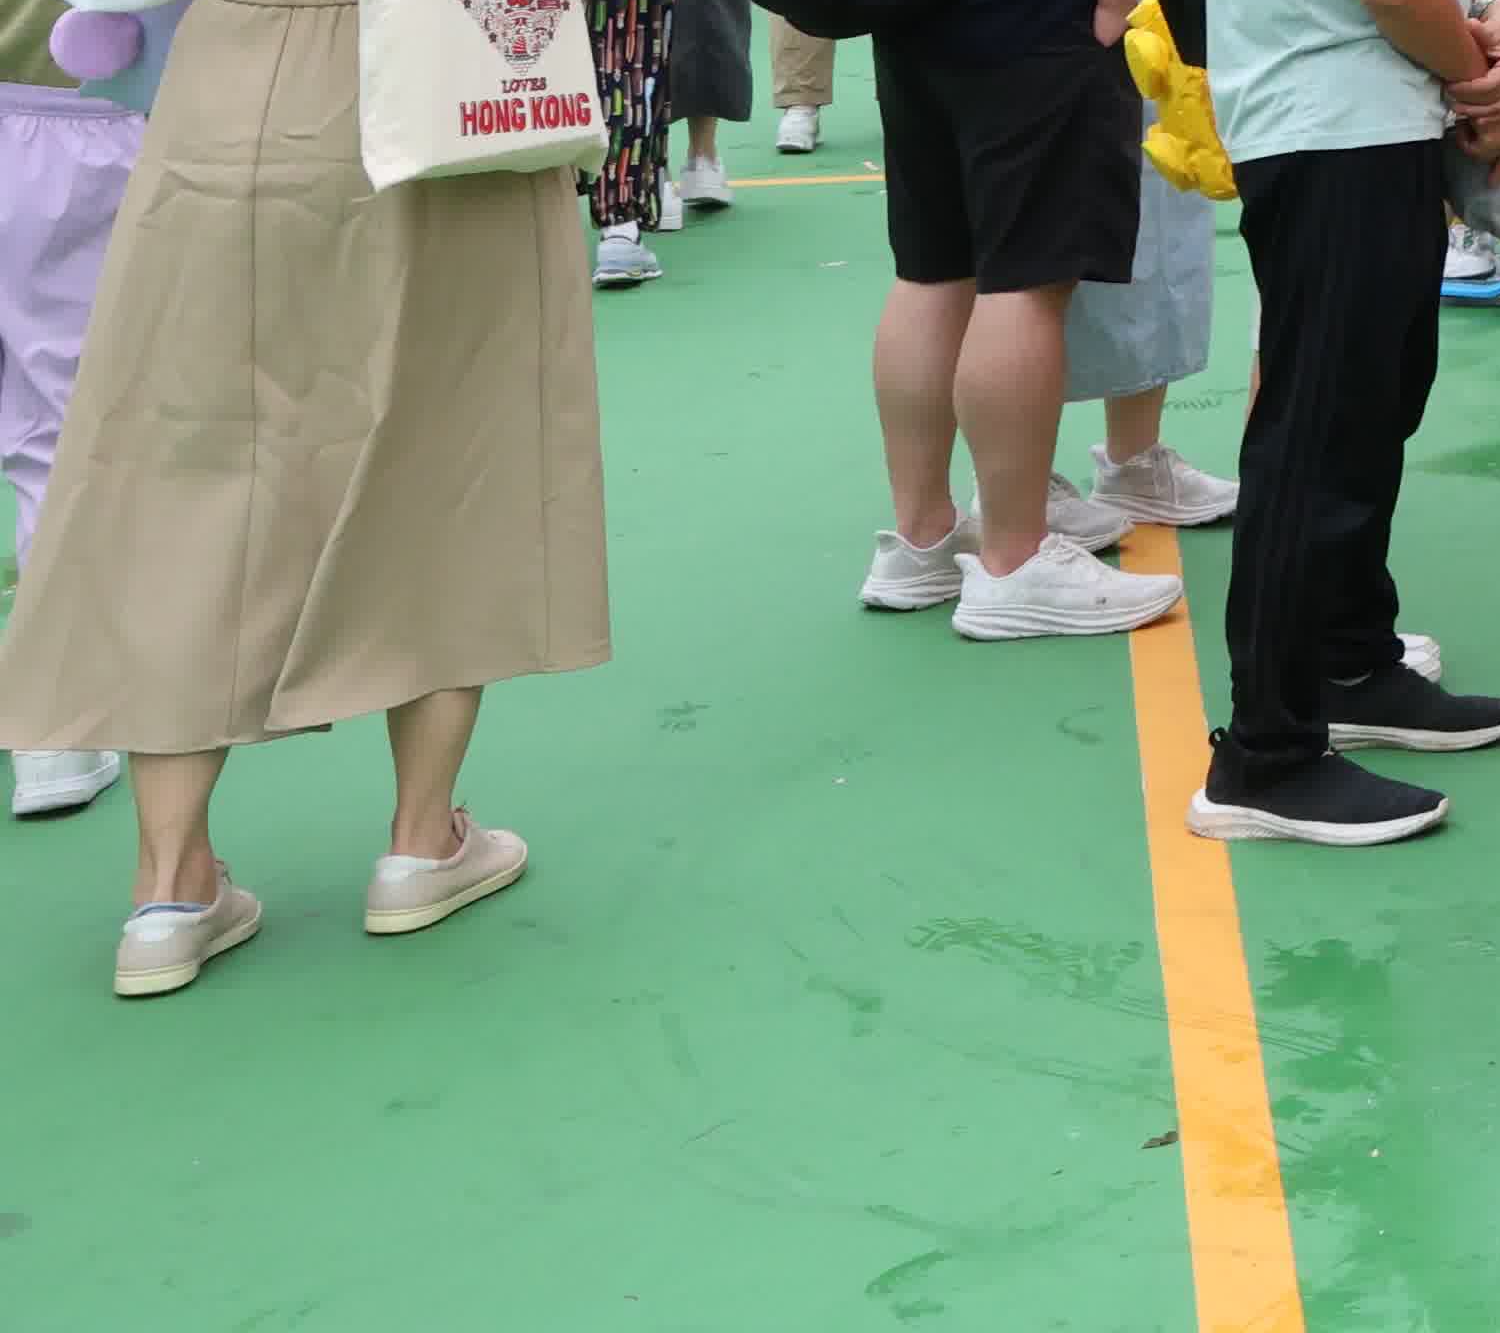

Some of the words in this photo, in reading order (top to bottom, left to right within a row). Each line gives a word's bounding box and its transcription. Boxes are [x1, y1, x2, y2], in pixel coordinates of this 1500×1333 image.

[501, 76, 547, 94] LOVES
[460, 96, 528, 137] HONG
[530, 91, 592, 131] KONG
